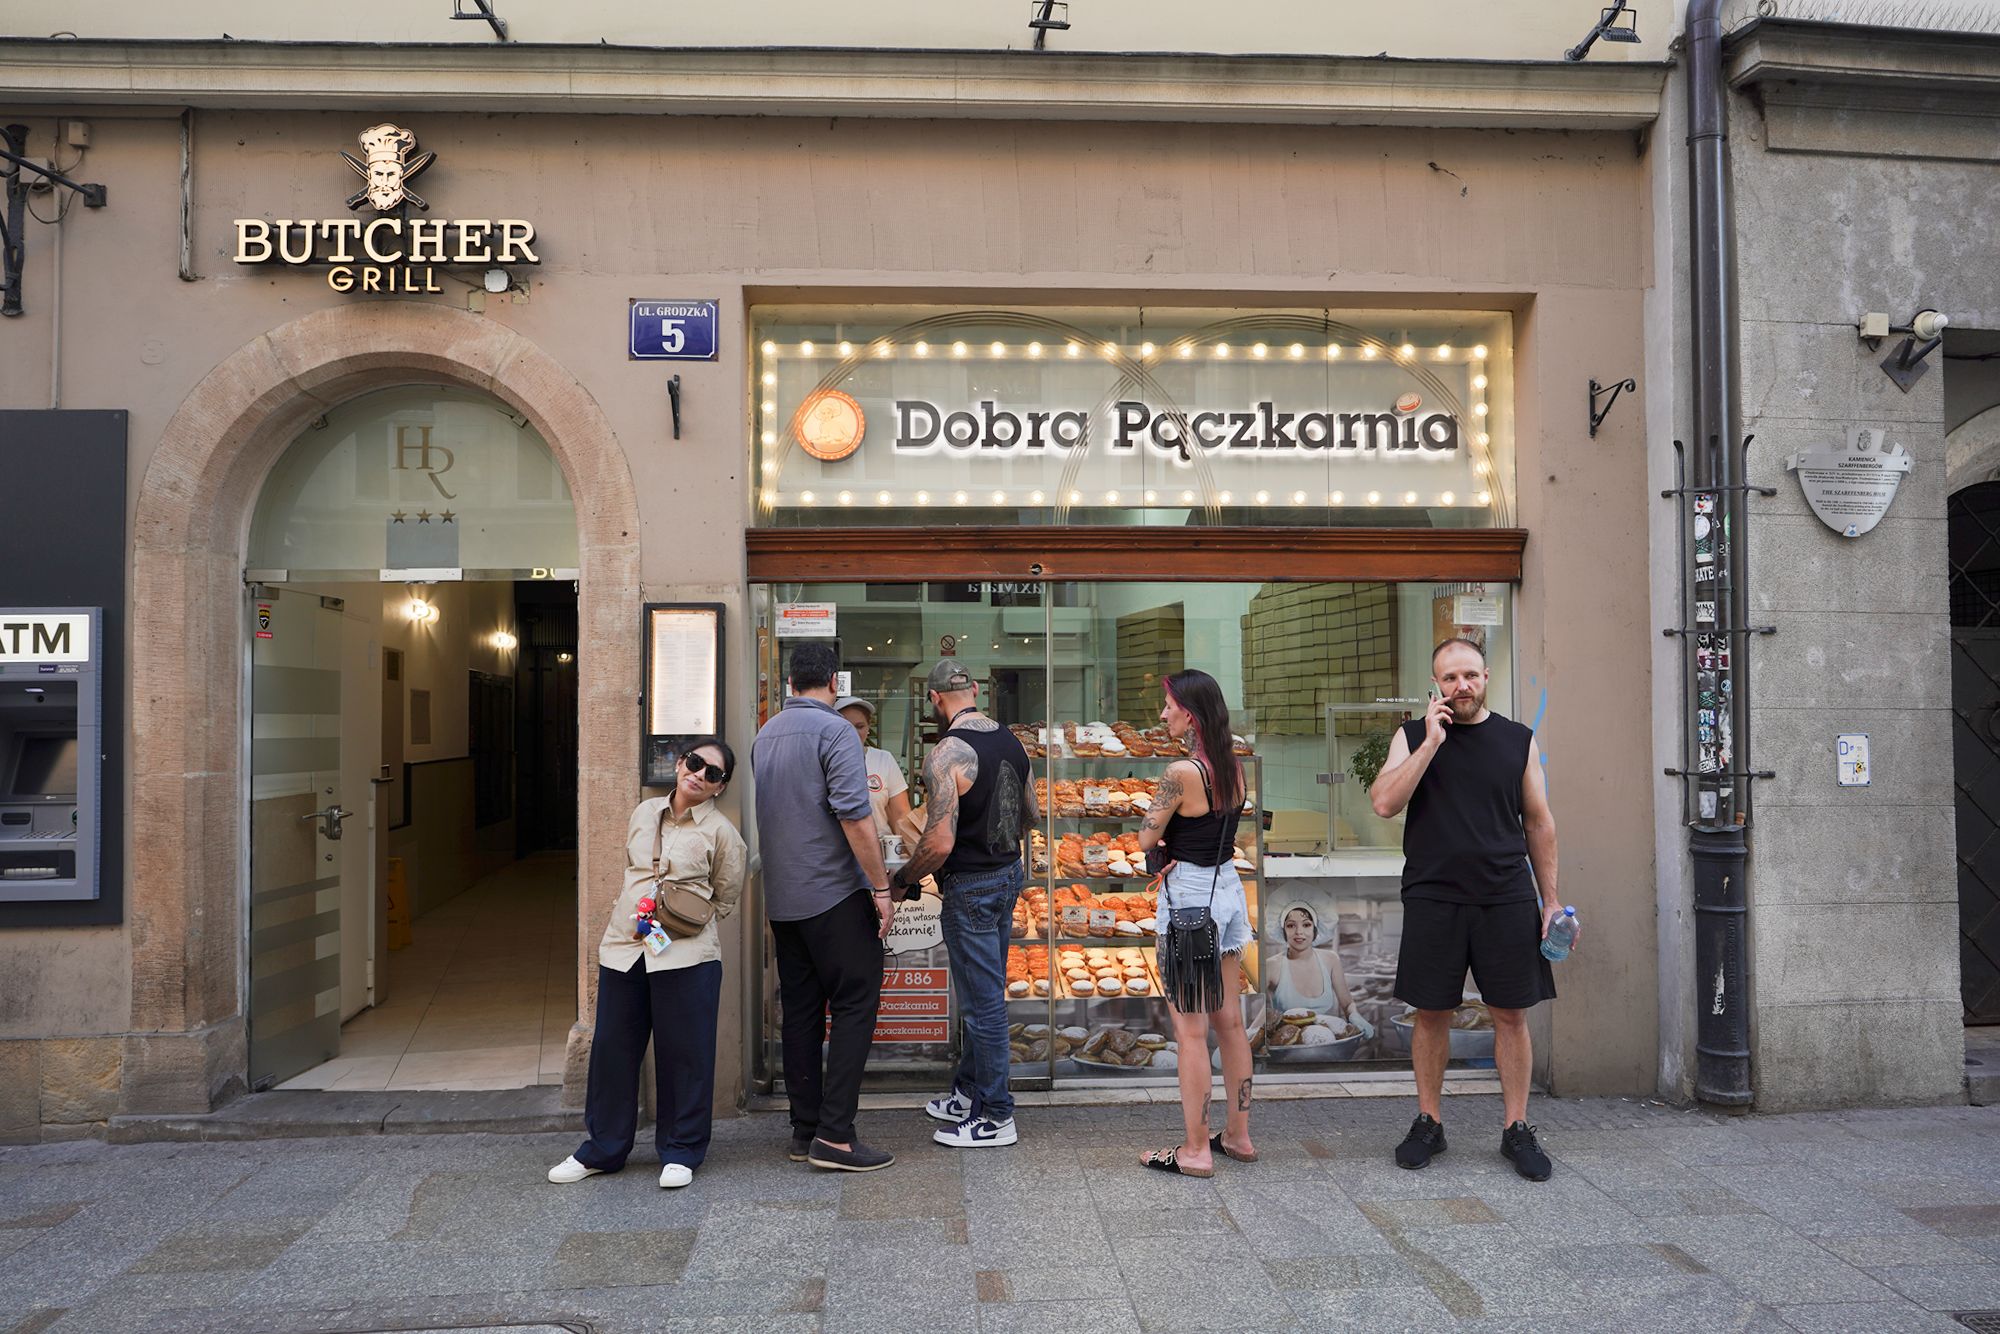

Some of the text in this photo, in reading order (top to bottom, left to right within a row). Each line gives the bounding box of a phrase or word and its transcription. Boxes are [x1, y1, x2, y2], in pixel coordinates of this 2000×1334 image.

[233, 218, 539, 263] BUTCHER
[327, 266, 441, 292] GRILL
[639, 306, 708, 317] UL. GRODZKA
[661, 318, 686, 353] 5
[895, 400, 1459, 460] Dobra Pączkarnia
[0, 623, 70, 654] TM
[904, 904, 925, 913] nami
[905, 972, 932, 985] 886
[879, 1001, 939, 1011] Paczkarnia
